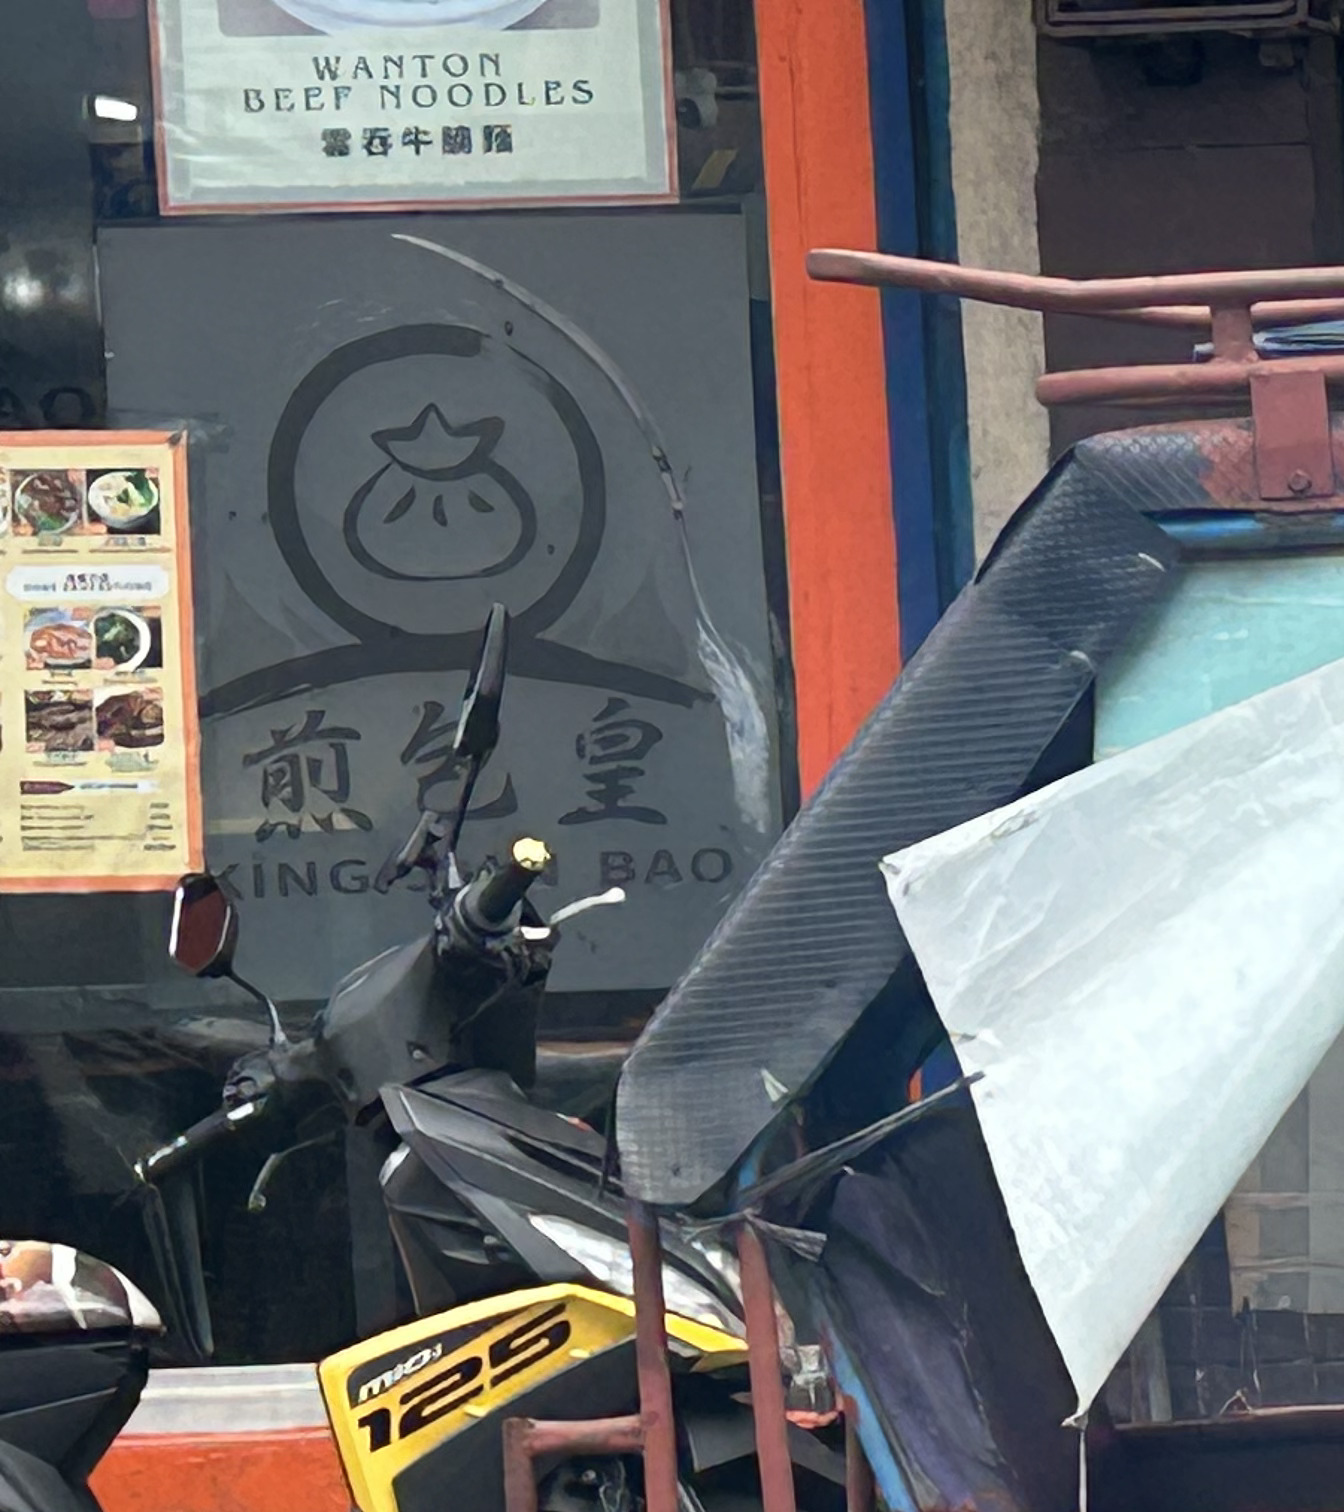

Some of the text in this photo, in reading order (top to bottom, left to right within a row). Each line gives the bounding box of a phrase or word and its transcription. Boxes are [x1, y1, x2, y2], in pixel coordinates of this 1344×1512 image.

[312, 52, 502, 81] WANTON
[243, 79, 595, 113] BEEF NOODLES
[600, 847, 734, 887] BAO
[358, 1302, 571, 1453] 125
